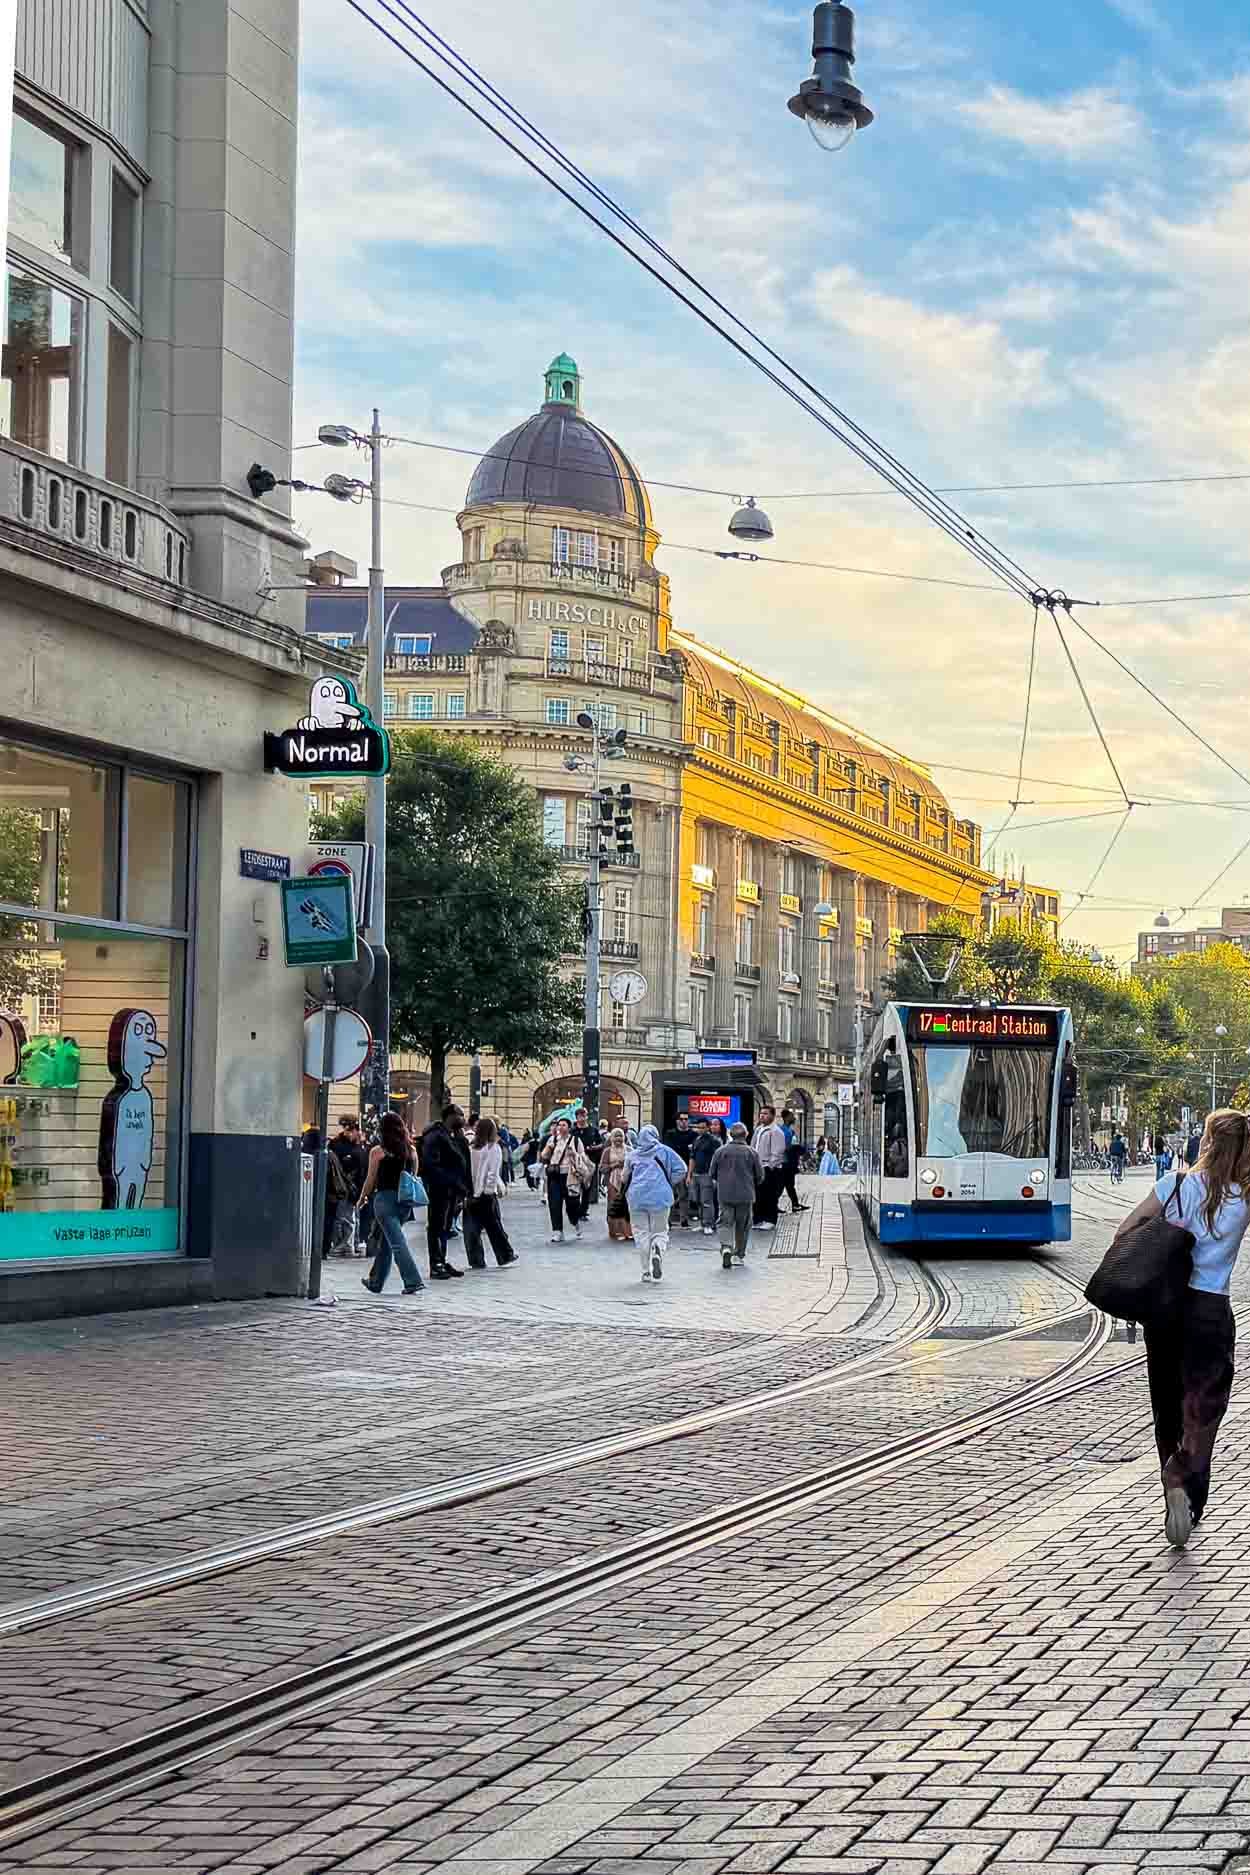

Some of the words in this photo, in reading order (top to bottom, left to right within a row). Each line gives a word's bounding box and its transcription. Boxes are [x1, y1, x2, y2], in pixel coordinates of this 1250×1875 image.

[528, 599, 615, 629] HIRSCH
[289, 736, 369, 763] Normal
[317, 847, 347, 856] ZONE
[920, 1013, 932, 1032] 17
[945, 1013, 997, 1034] Centraal
[1001, 1015, 1047, 1035] Station
